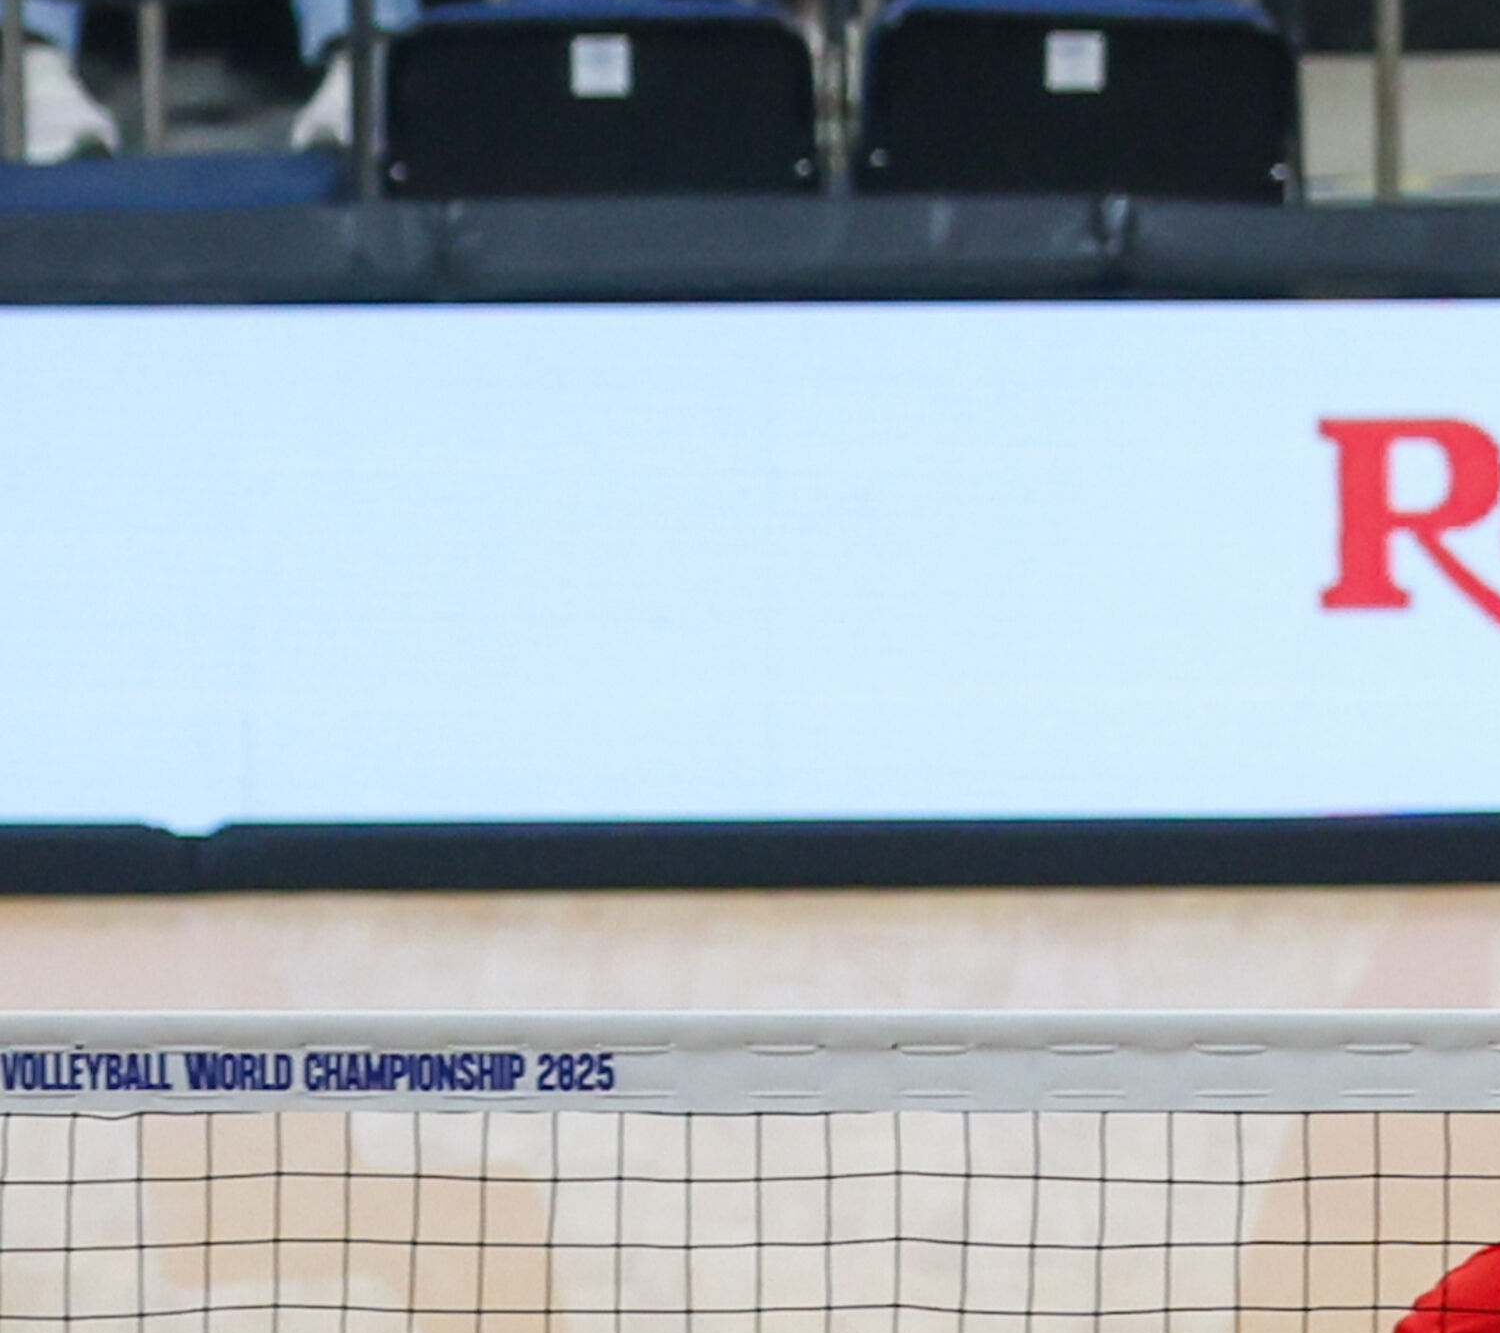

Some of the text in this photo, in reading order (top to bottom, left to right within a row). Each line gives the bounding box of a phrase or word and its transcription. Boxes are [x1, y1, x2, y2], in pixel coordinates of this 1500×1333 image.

[1, 1052, 172, 1091] VOLLEYBALL
[183, 1052, 293, 1091] WORLD
[304, 1052, 525, 1092] CHAMPIONSHIP
